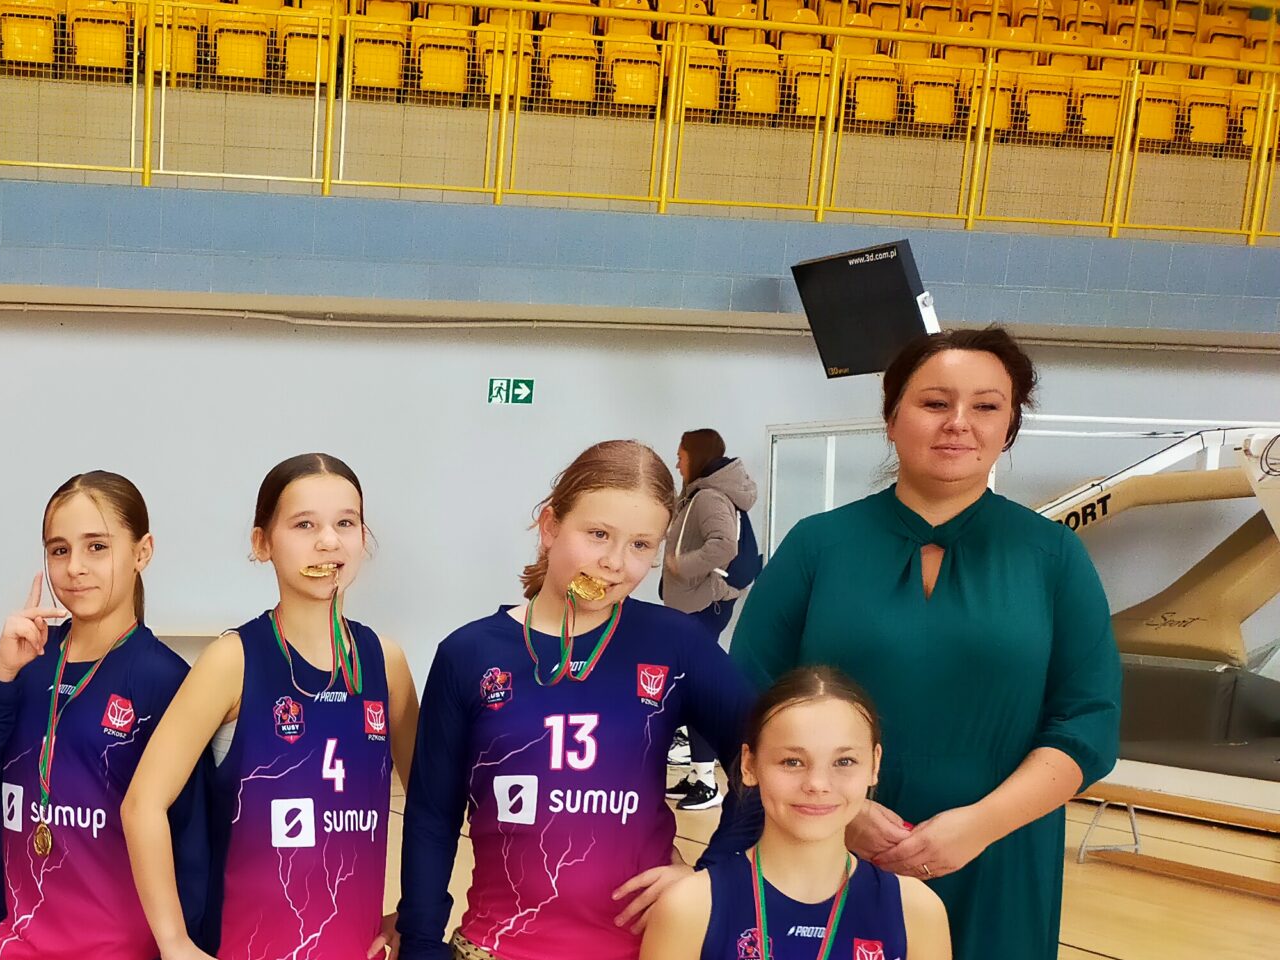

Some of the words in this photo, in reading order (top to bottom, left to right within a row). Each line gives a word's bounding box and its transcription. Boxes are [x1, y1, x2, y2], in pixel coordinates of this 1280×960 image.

[320, 691, 348, 702] PROTON
[544, 713, 599, 771] 13
[322, 738, 346, 792] 4
[30, 801, 106, 838] sumup
[548, 789, 639, 825] sumup
[323, 809, 378, 842] sumup
[795, 926, 826, 938] PROTO
